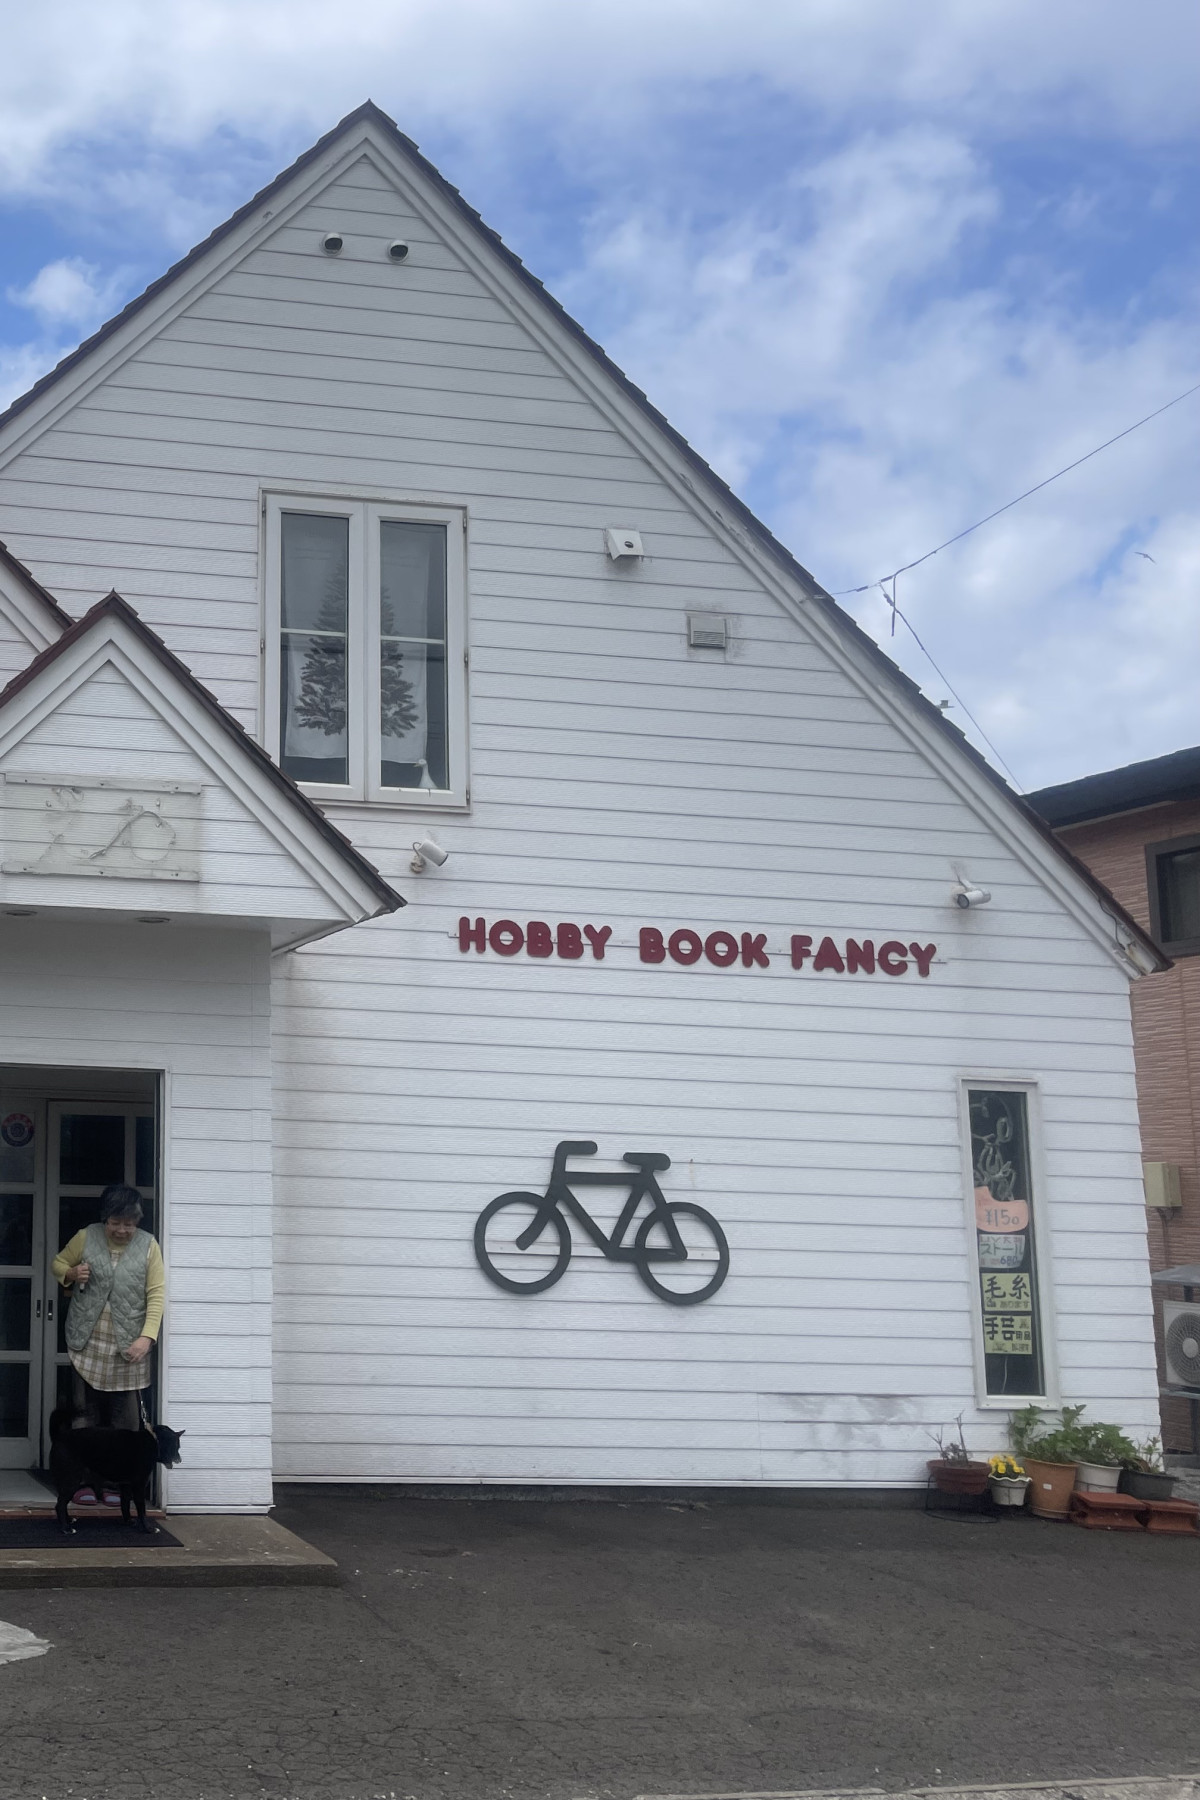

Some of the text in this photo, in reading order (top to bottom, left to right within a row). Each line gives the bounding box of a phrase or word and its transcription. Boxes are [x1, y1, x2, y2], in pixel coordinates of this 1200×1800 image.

[458, 916, 937, 978] HOBBY BOOK FANCY
[984, 1208, 1020, 1227] ¥150
[980, 1243, 1024, 1256] ストール
[985, 1275, 1030, 1300] 毛糸
